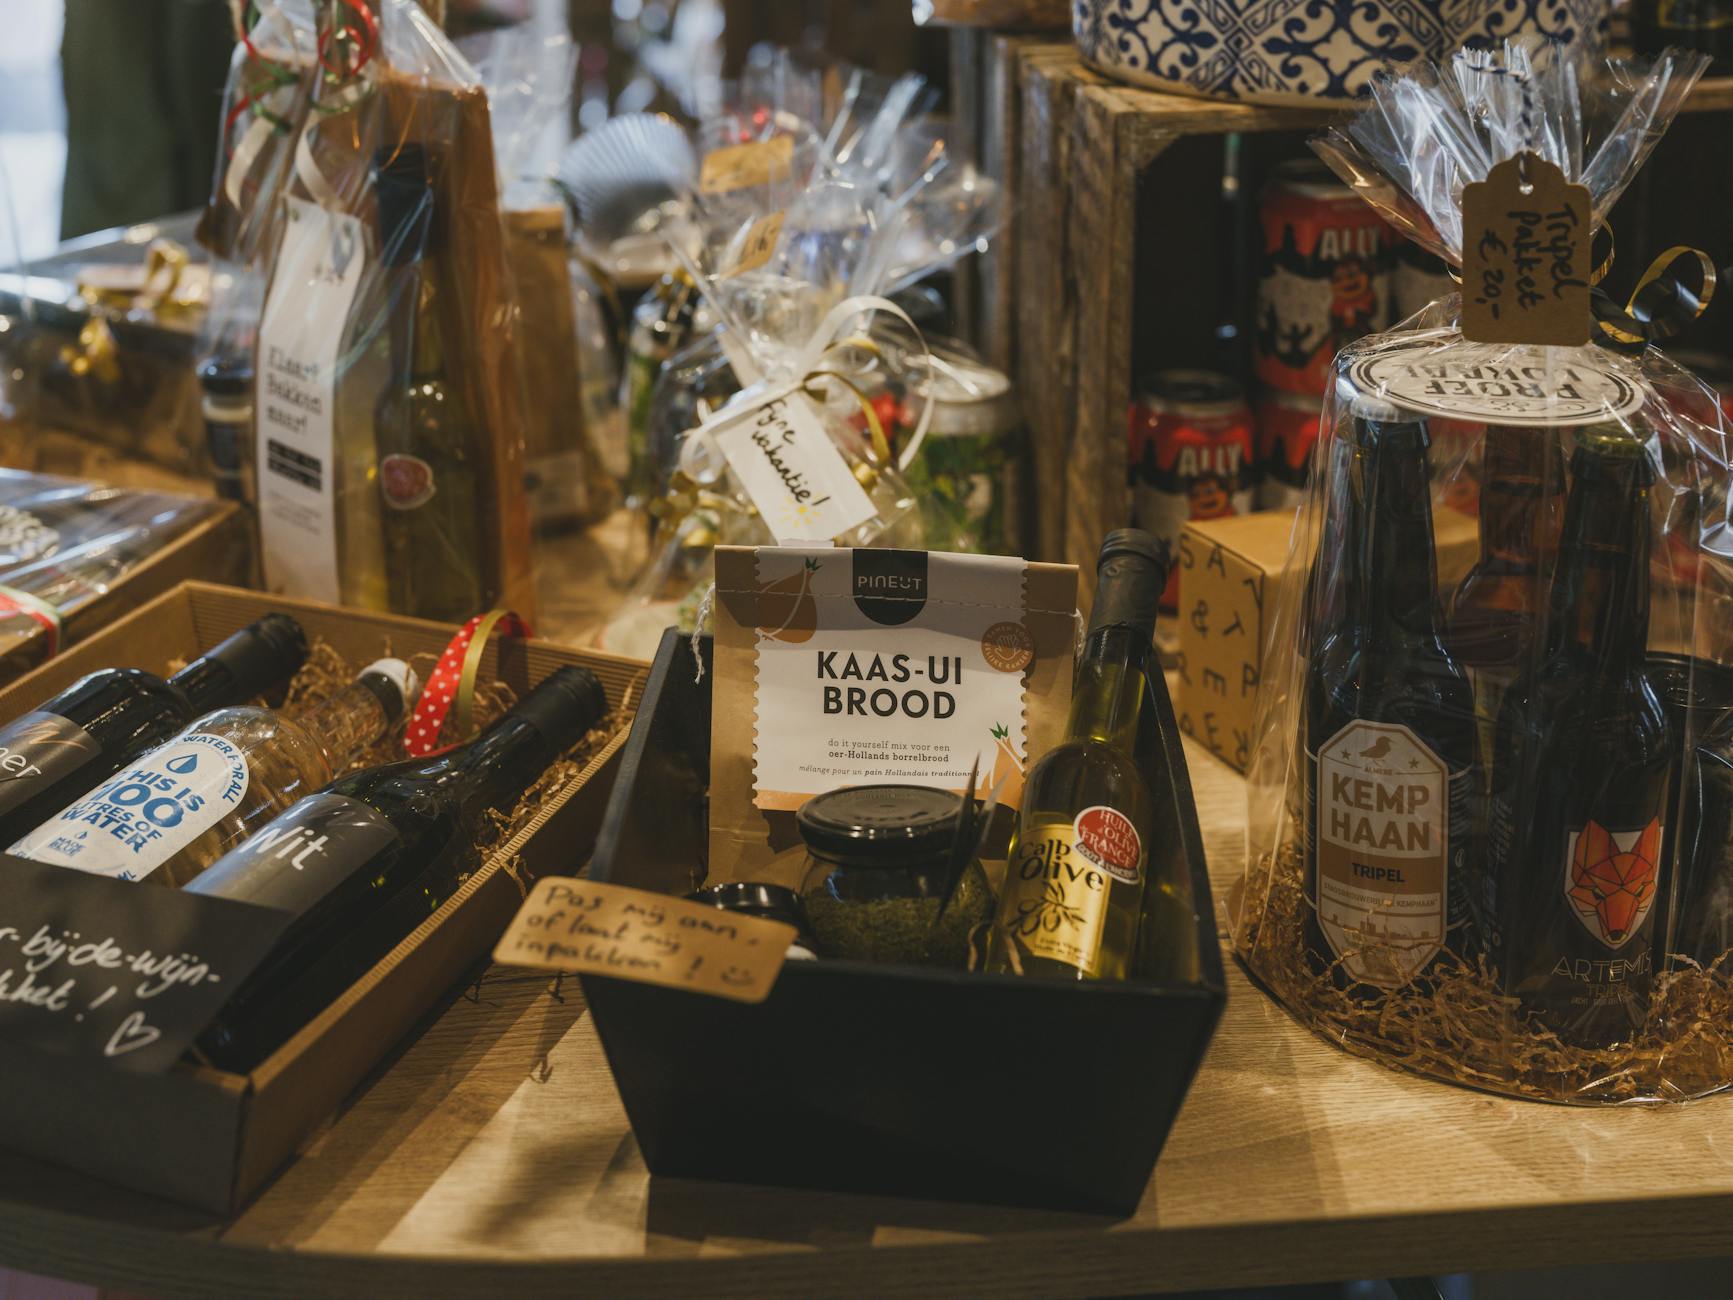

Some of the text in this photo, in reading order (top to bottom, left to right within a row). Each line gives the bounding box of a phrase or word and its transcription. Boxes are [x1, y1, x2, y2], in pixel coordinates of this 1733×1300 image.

[1478, 228, 1508, 263] €
[1546, 202, 1589, 300] Tripel
[857, 575, 922, 590] PINEUT
[817, 651, 962, 685] KAAS-UI
[823, 686, 956, 719] BROOD
[828, 738, 950, 752] do it yourself mix voor een
[828, 751, 949, 762] oer-Hollands borrelbrood
[183, 734, 233, 754] WATER
[222, 779, 242, 803] ALL
[832, 768, 850, 776] pour
[864, 769, 883, 777] pain
[884, 768, 929, 777] Hollandais
[931, 769, 980, 777] traditionnl
[174, 787, 205, 812] IS
[1332, 771, 1430, 815] KEMP
[61, 809, 148, 853] WATER
[135, 820, 163, 840] OF
[1100, 810, 1134, 839] HUILE
[1331, 807, 1431, 851] HAAN
[239, 826, 329, 871] Wit
[1081, 830, 1132, 867] FRANCE
[1352, 862, 1406, 883] TRIPEL
